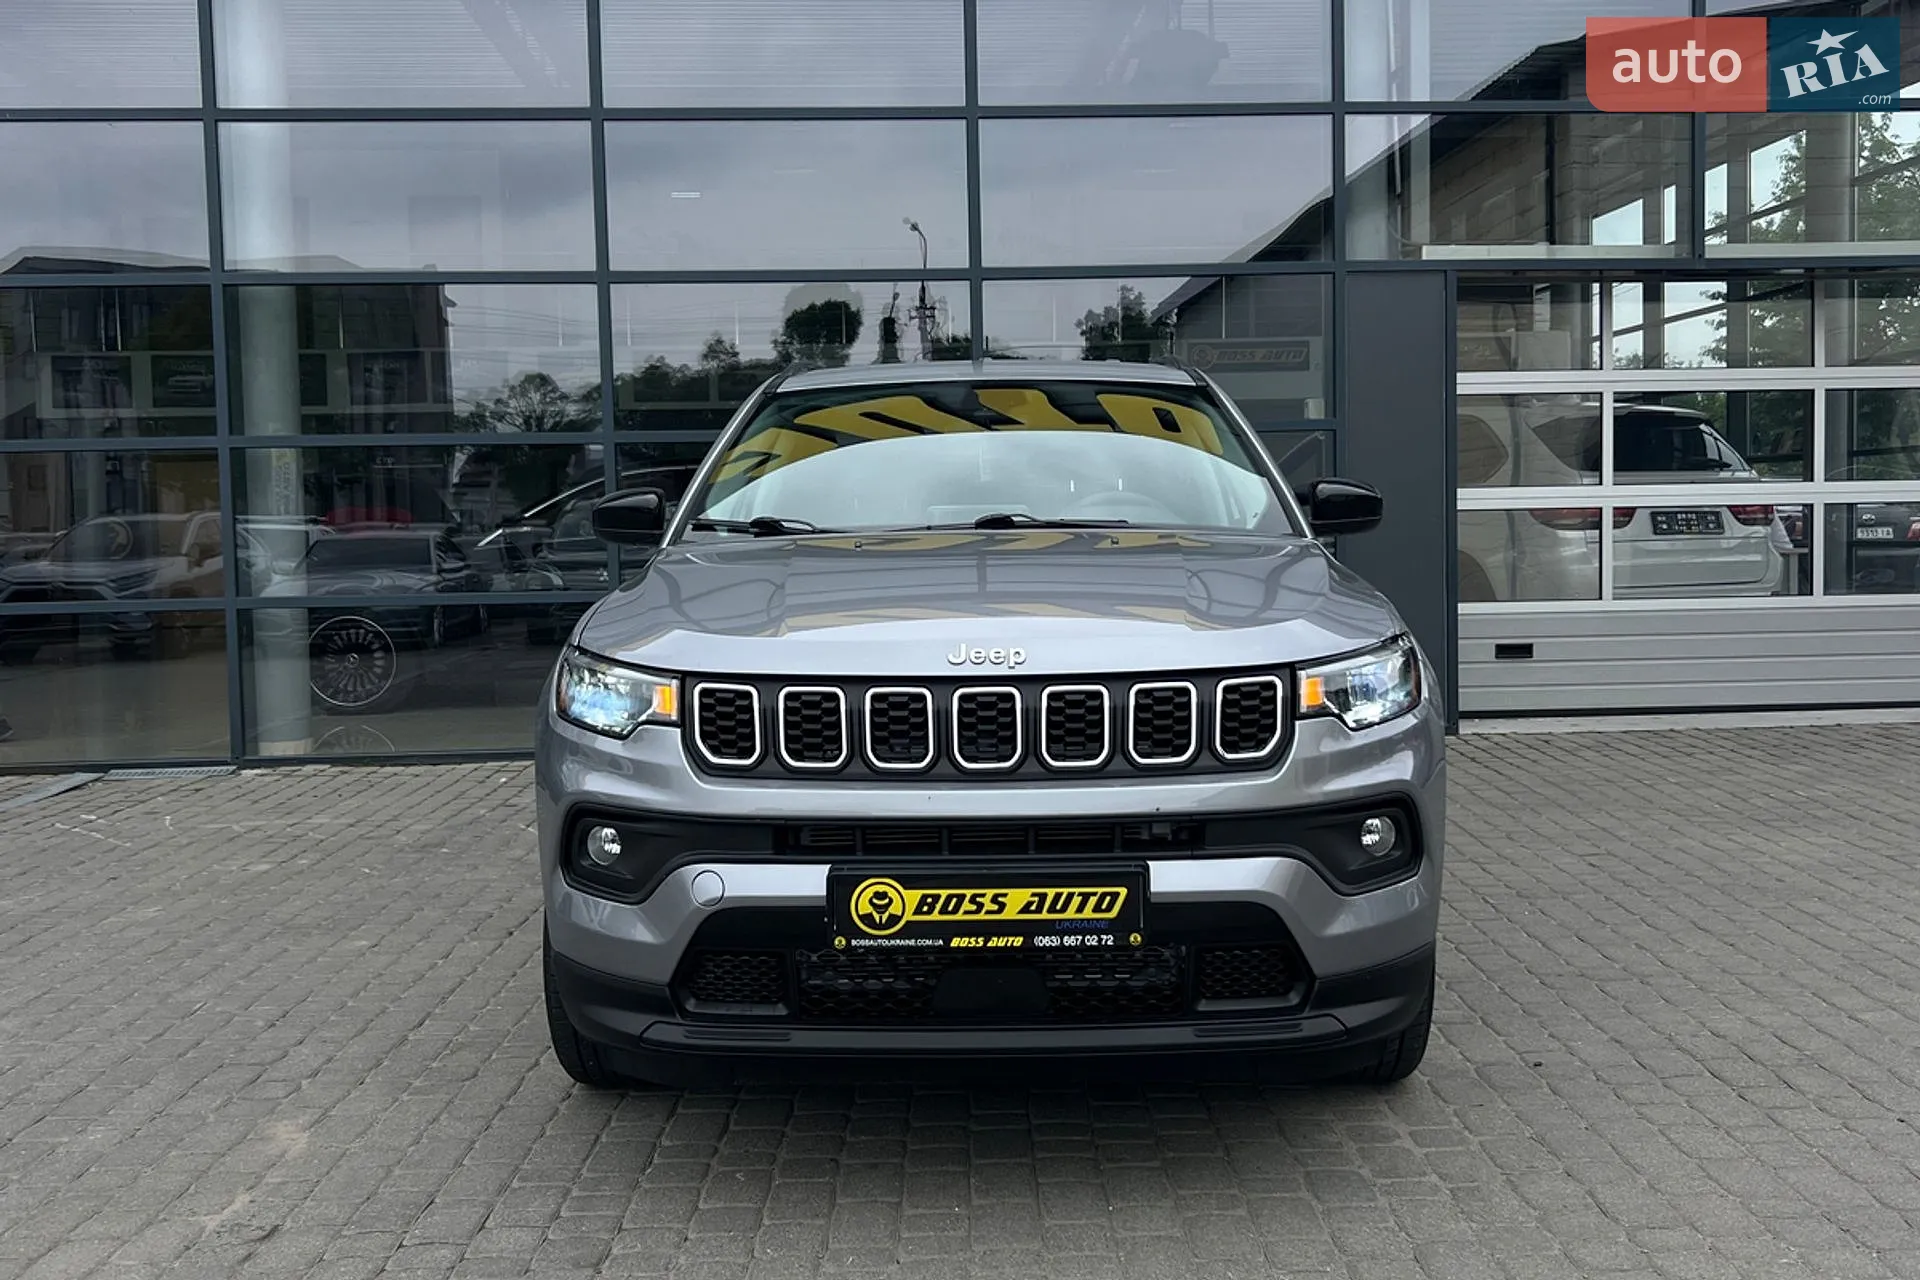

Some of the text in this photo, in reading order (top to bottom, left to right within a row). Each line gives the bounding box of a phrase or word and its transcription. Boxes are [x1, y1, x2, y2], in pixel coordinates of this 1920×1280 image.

[947, 643, 1027, 669] Jeep
[912, 891, 1122, 915] BOSS AUTO
[1055, 920, 1109, 930] UKRAINE
[950, 936, 1024, 947] BOSS AUTO
[1100, 934, 1114, 946] 72
